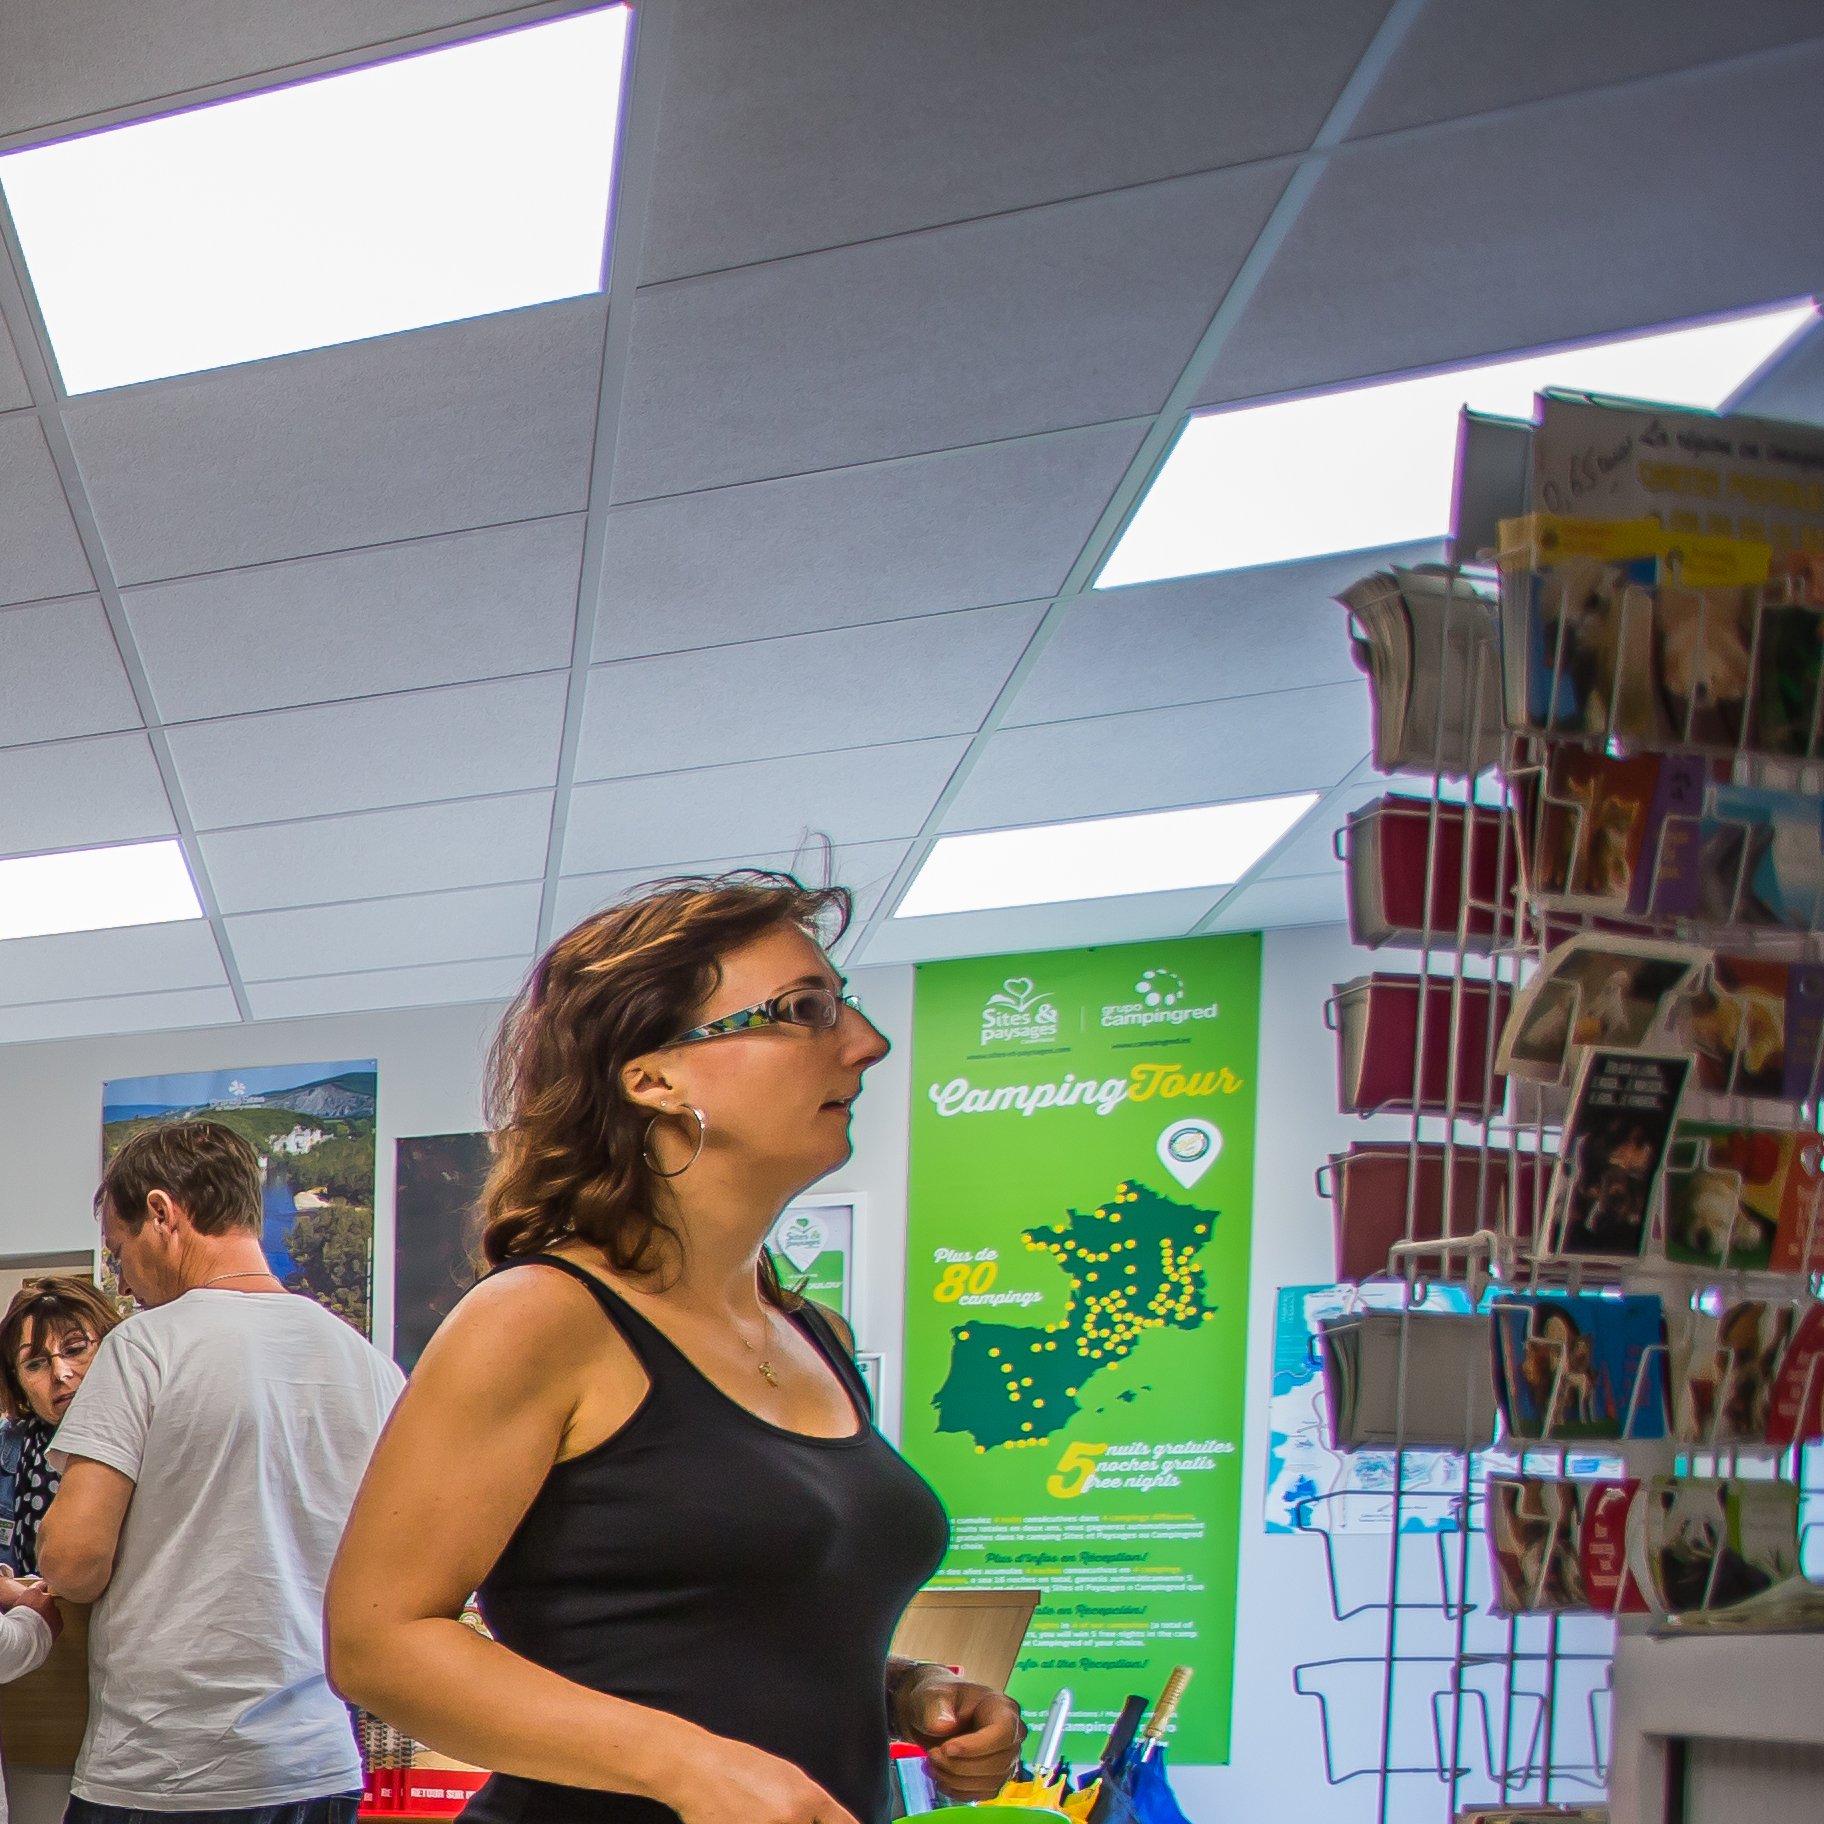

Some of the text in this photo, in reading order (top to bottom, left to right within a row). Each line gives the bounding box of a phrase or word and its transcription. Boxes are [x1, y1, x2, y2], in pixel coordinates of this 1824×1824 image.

[981, 1003, 1058, 1029] Sites &
[1101, 1002, 1142, 1016] grupo
[1101, 1003, 1218, 1027] campingred
[933, 1248, 999, 1264] Plus de
[932, 1260, 998, 1304] 80
[958, 1289, 1044, 1308] campings
[1105, 1439, 1236, 1459] nuits gratuites
[1046, 1441, 1109, 1500] 5
[1095, 1457, 1216, 1476] noches gratis
[1080, 1473, 1181, 1494] free nights
[410, 1788, 464, 1799] RETOUR SUR
